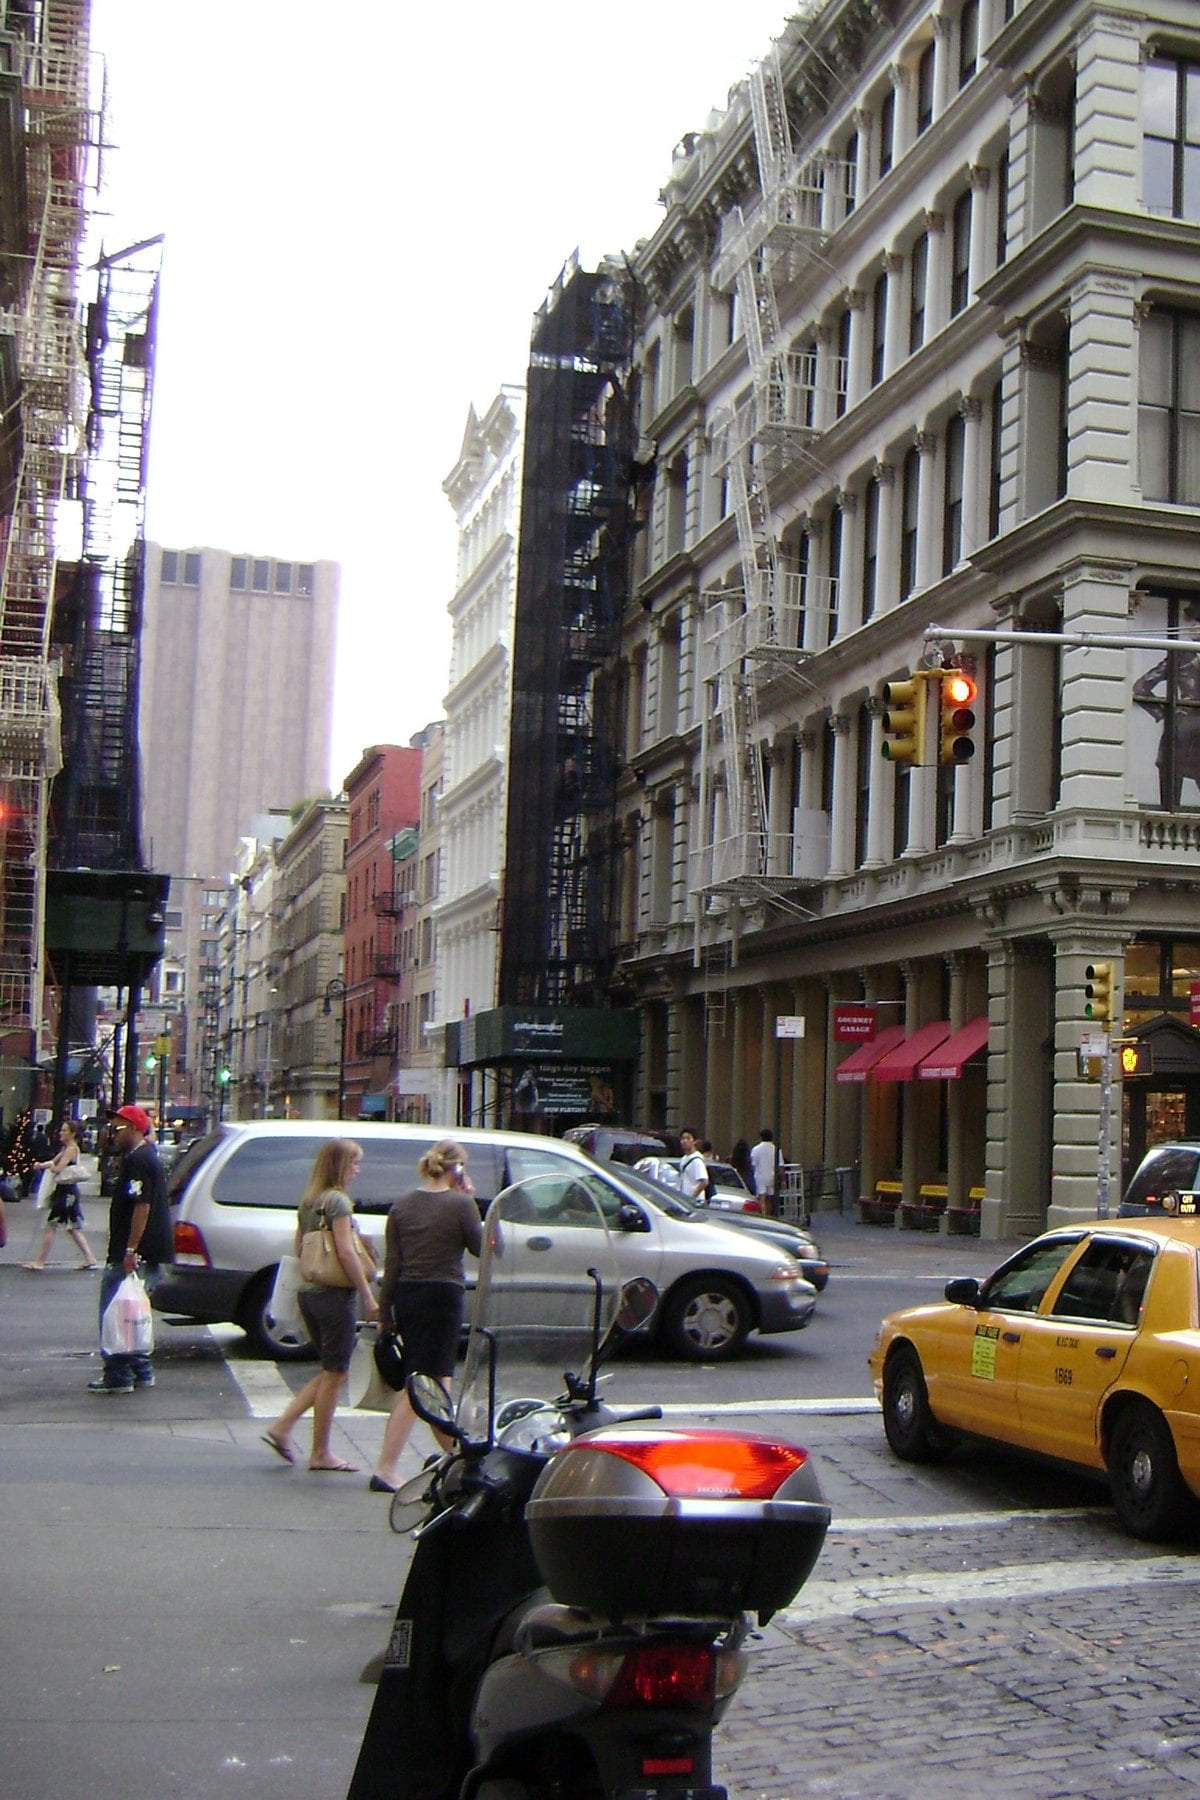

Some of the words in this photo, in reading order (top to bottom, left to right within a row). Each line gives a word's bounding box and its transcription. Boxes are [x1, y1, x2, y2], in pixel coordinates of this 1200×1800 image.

[837, 1016, 873, 1024] GOURMET
[1182, 1195, 1194, 1204] OFF
[1180, 1204, 1196, 1214] DUTY
